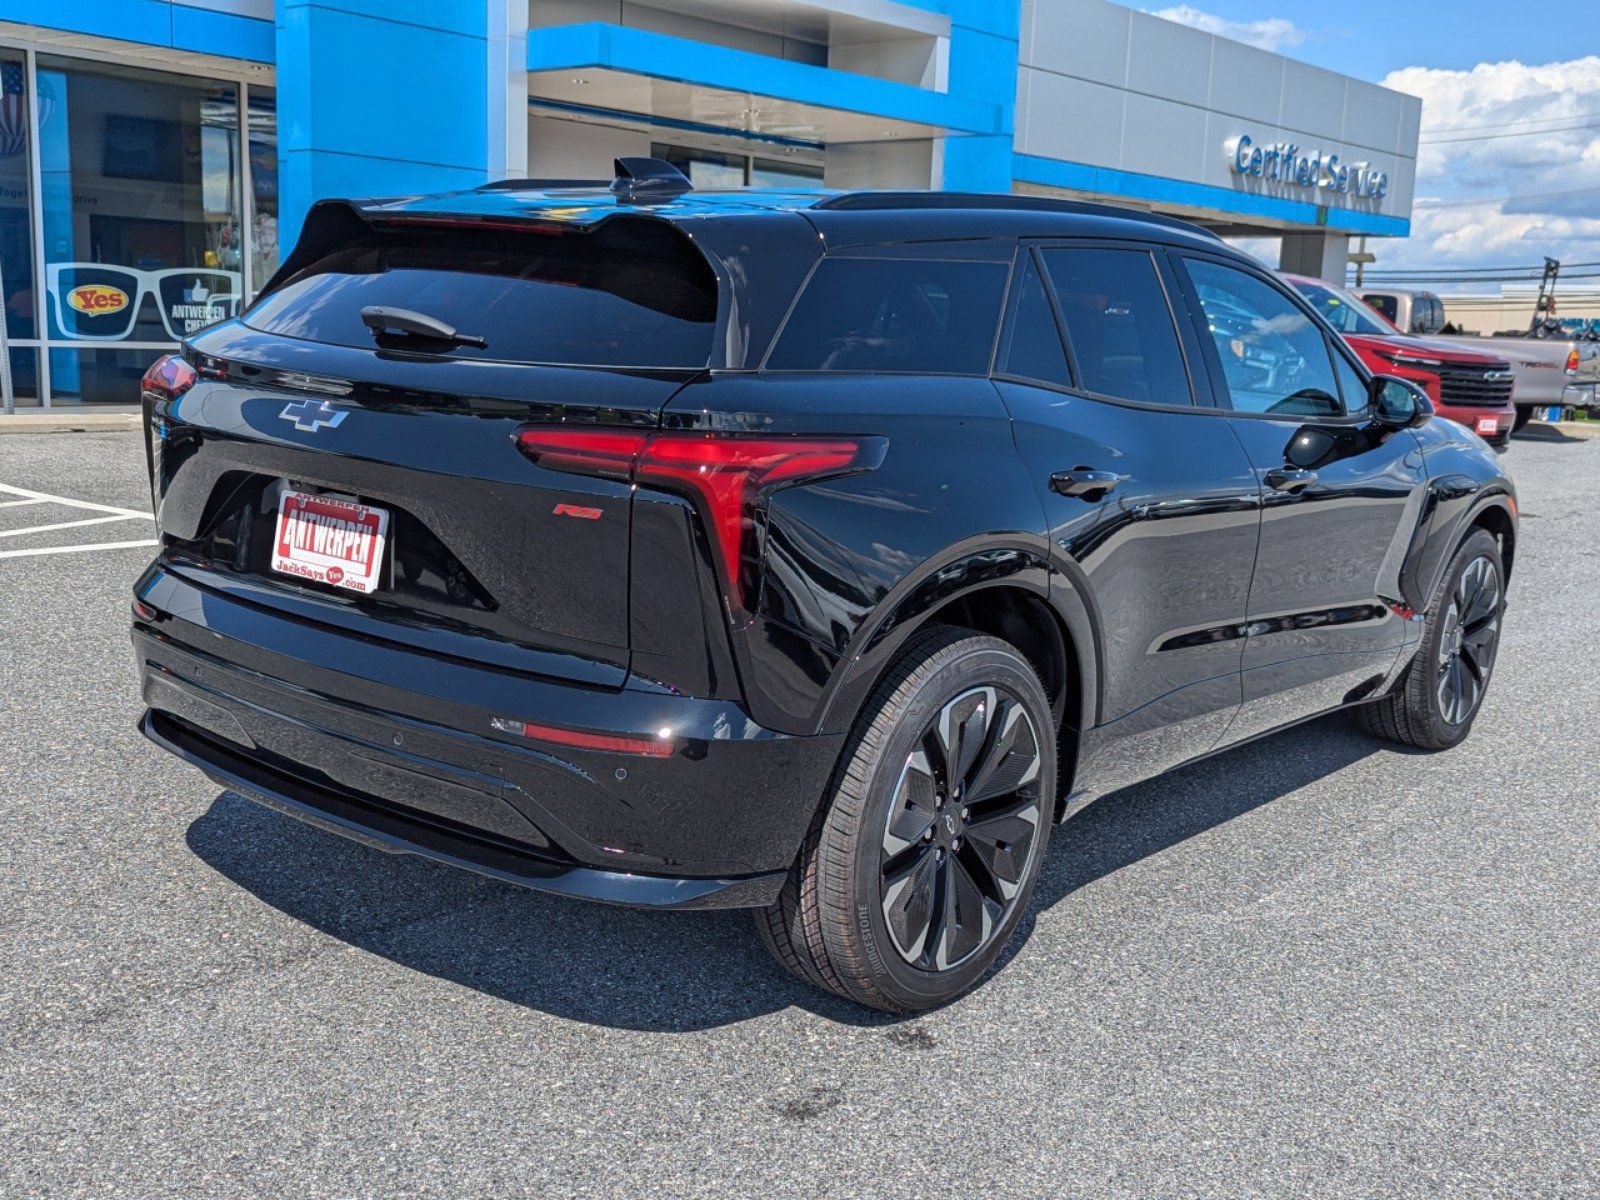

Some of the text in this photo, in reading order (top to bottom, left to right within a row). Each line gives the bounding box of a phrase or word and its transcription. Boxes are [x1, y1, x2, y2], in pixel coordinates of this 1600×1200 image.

[1229, 135, 1387, 199] Certified Service
[76, 289, 123, 310] Yes
[172, 304, 226, 320] ANTWERPEN
[283, 508, 373, 565] ANTWERPEN
